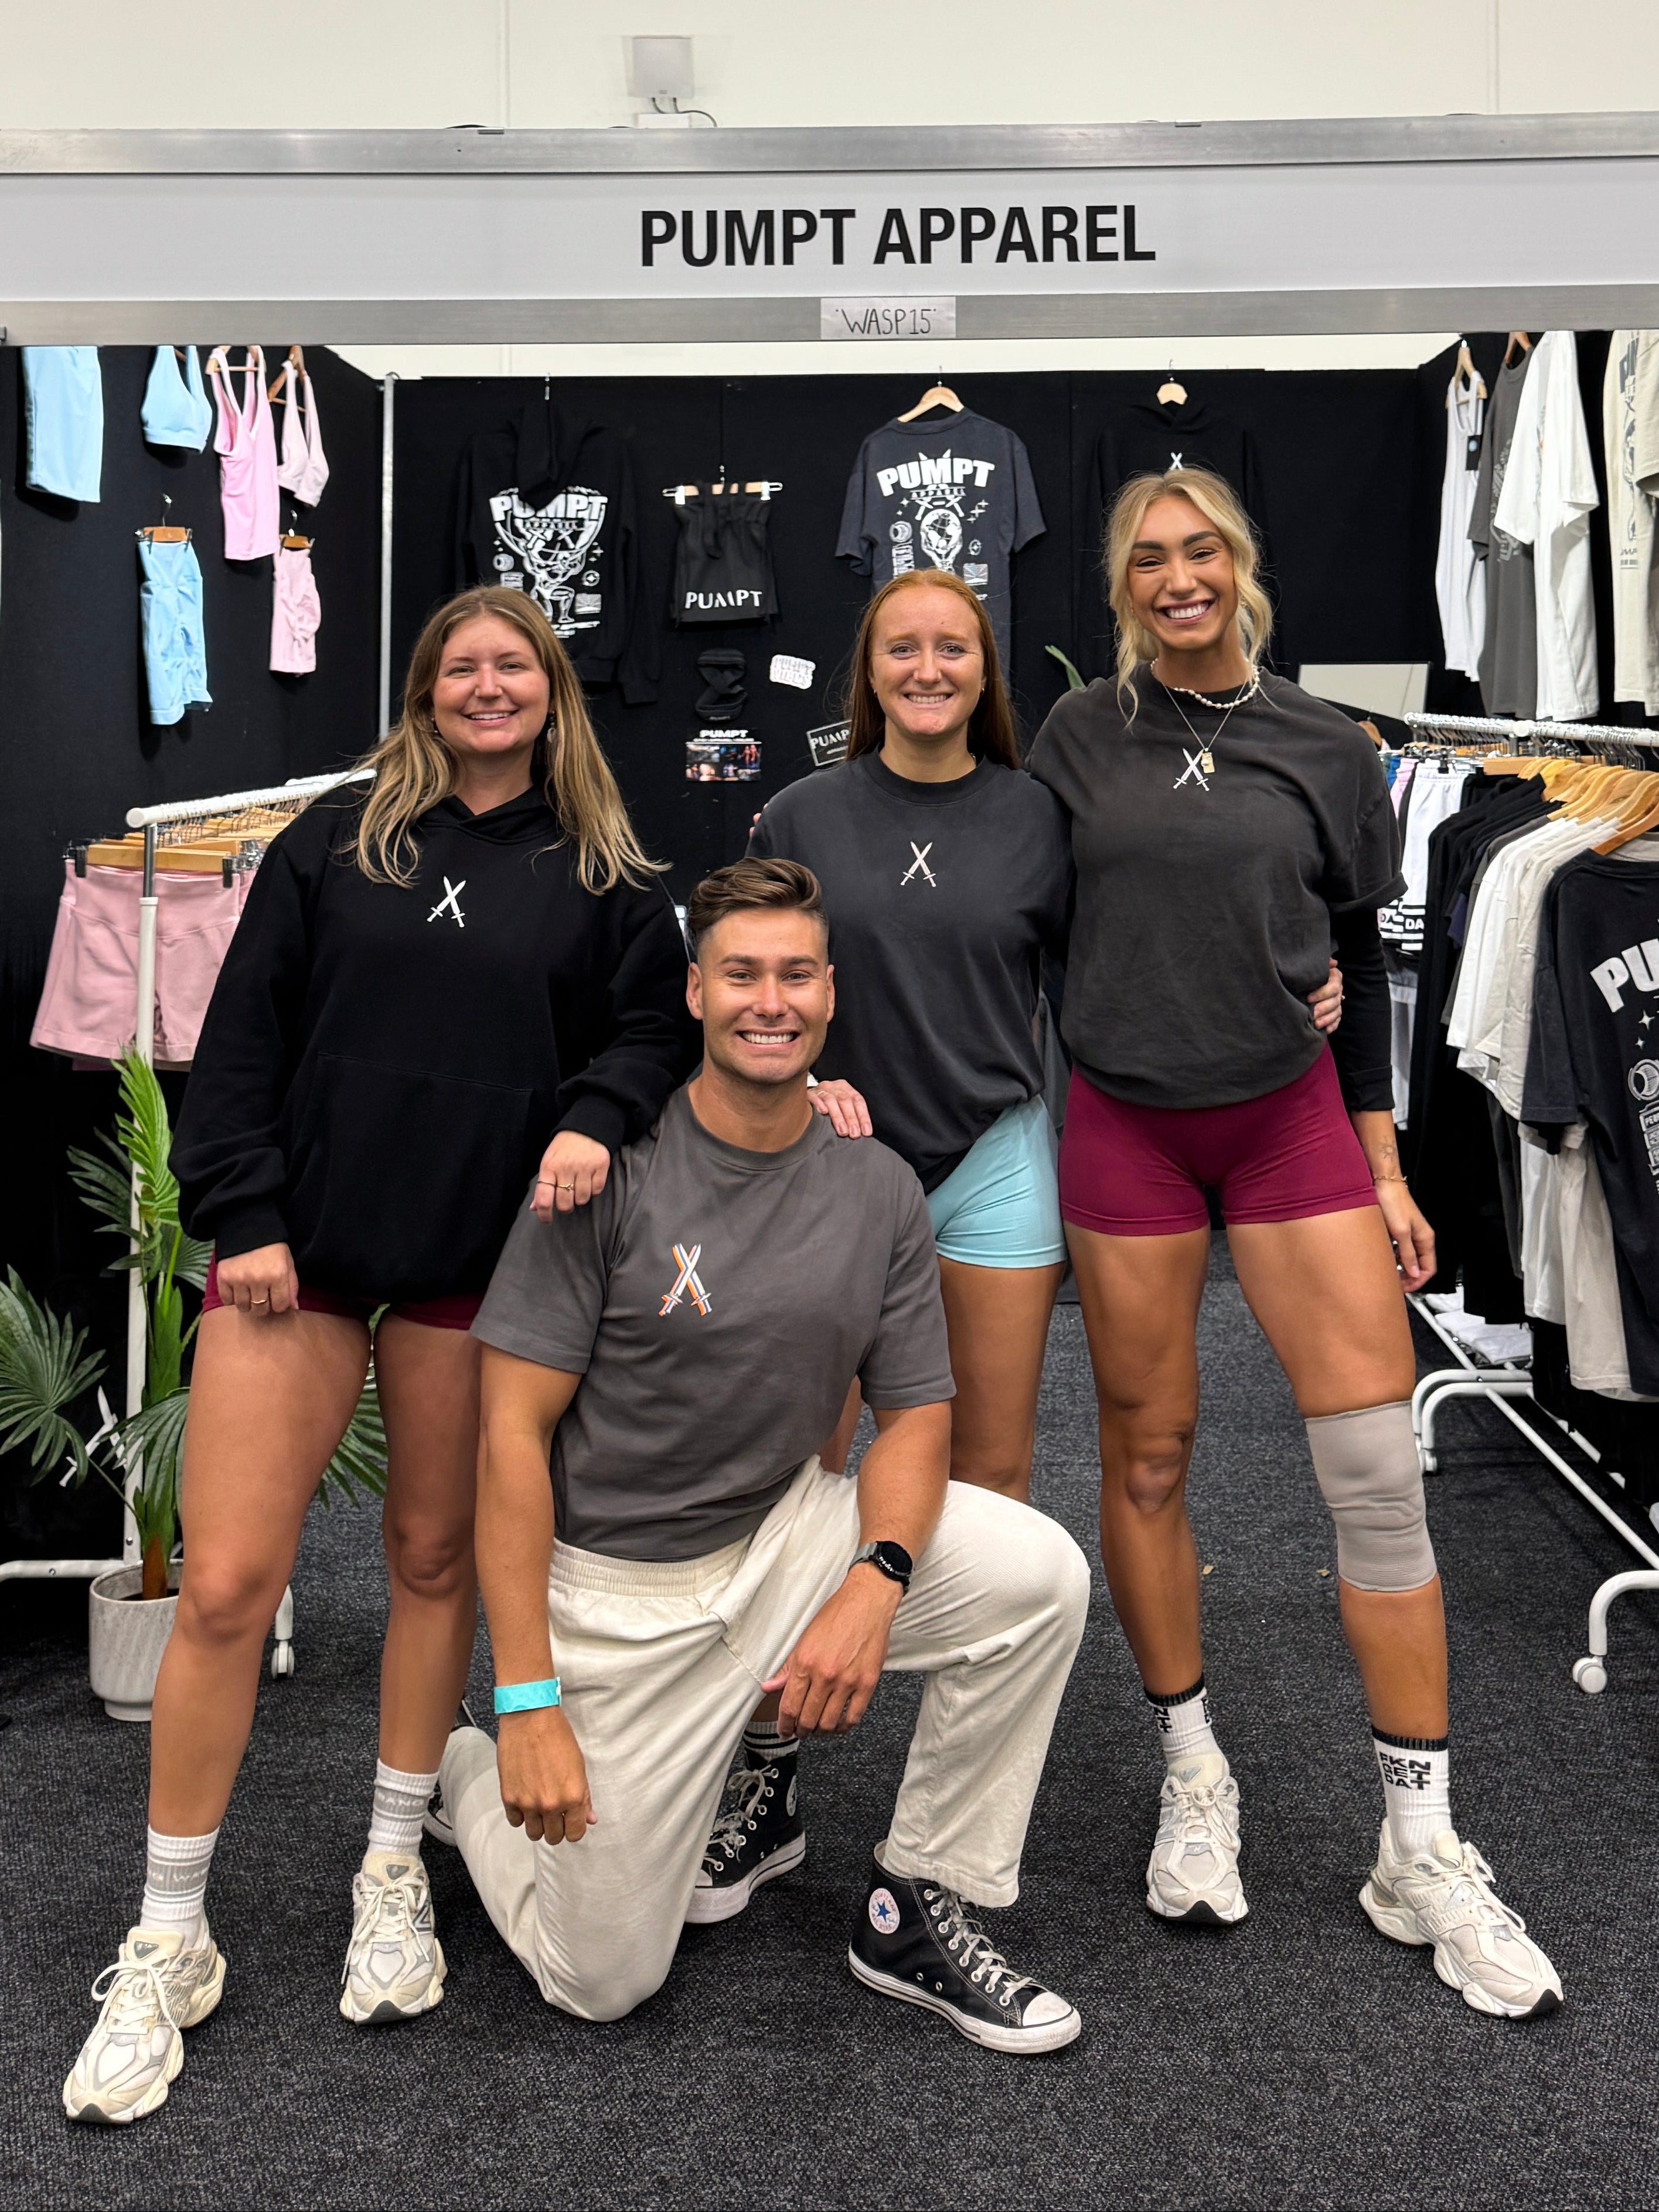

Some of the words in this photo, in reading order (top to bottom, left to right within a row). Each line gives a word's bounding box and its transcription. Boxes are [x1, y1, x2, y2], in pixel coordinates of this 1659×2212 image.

[641, 209, 856, 267] PUMPT
[873, 205, 1156, 264] APPAREL
[877, 458, 995, 496] PUMPT
[685, 590, 762, 609] PUMPT
[699, 729, 748, 738] PUMPT
[1379, 1751, 1431, 1771] FKN
